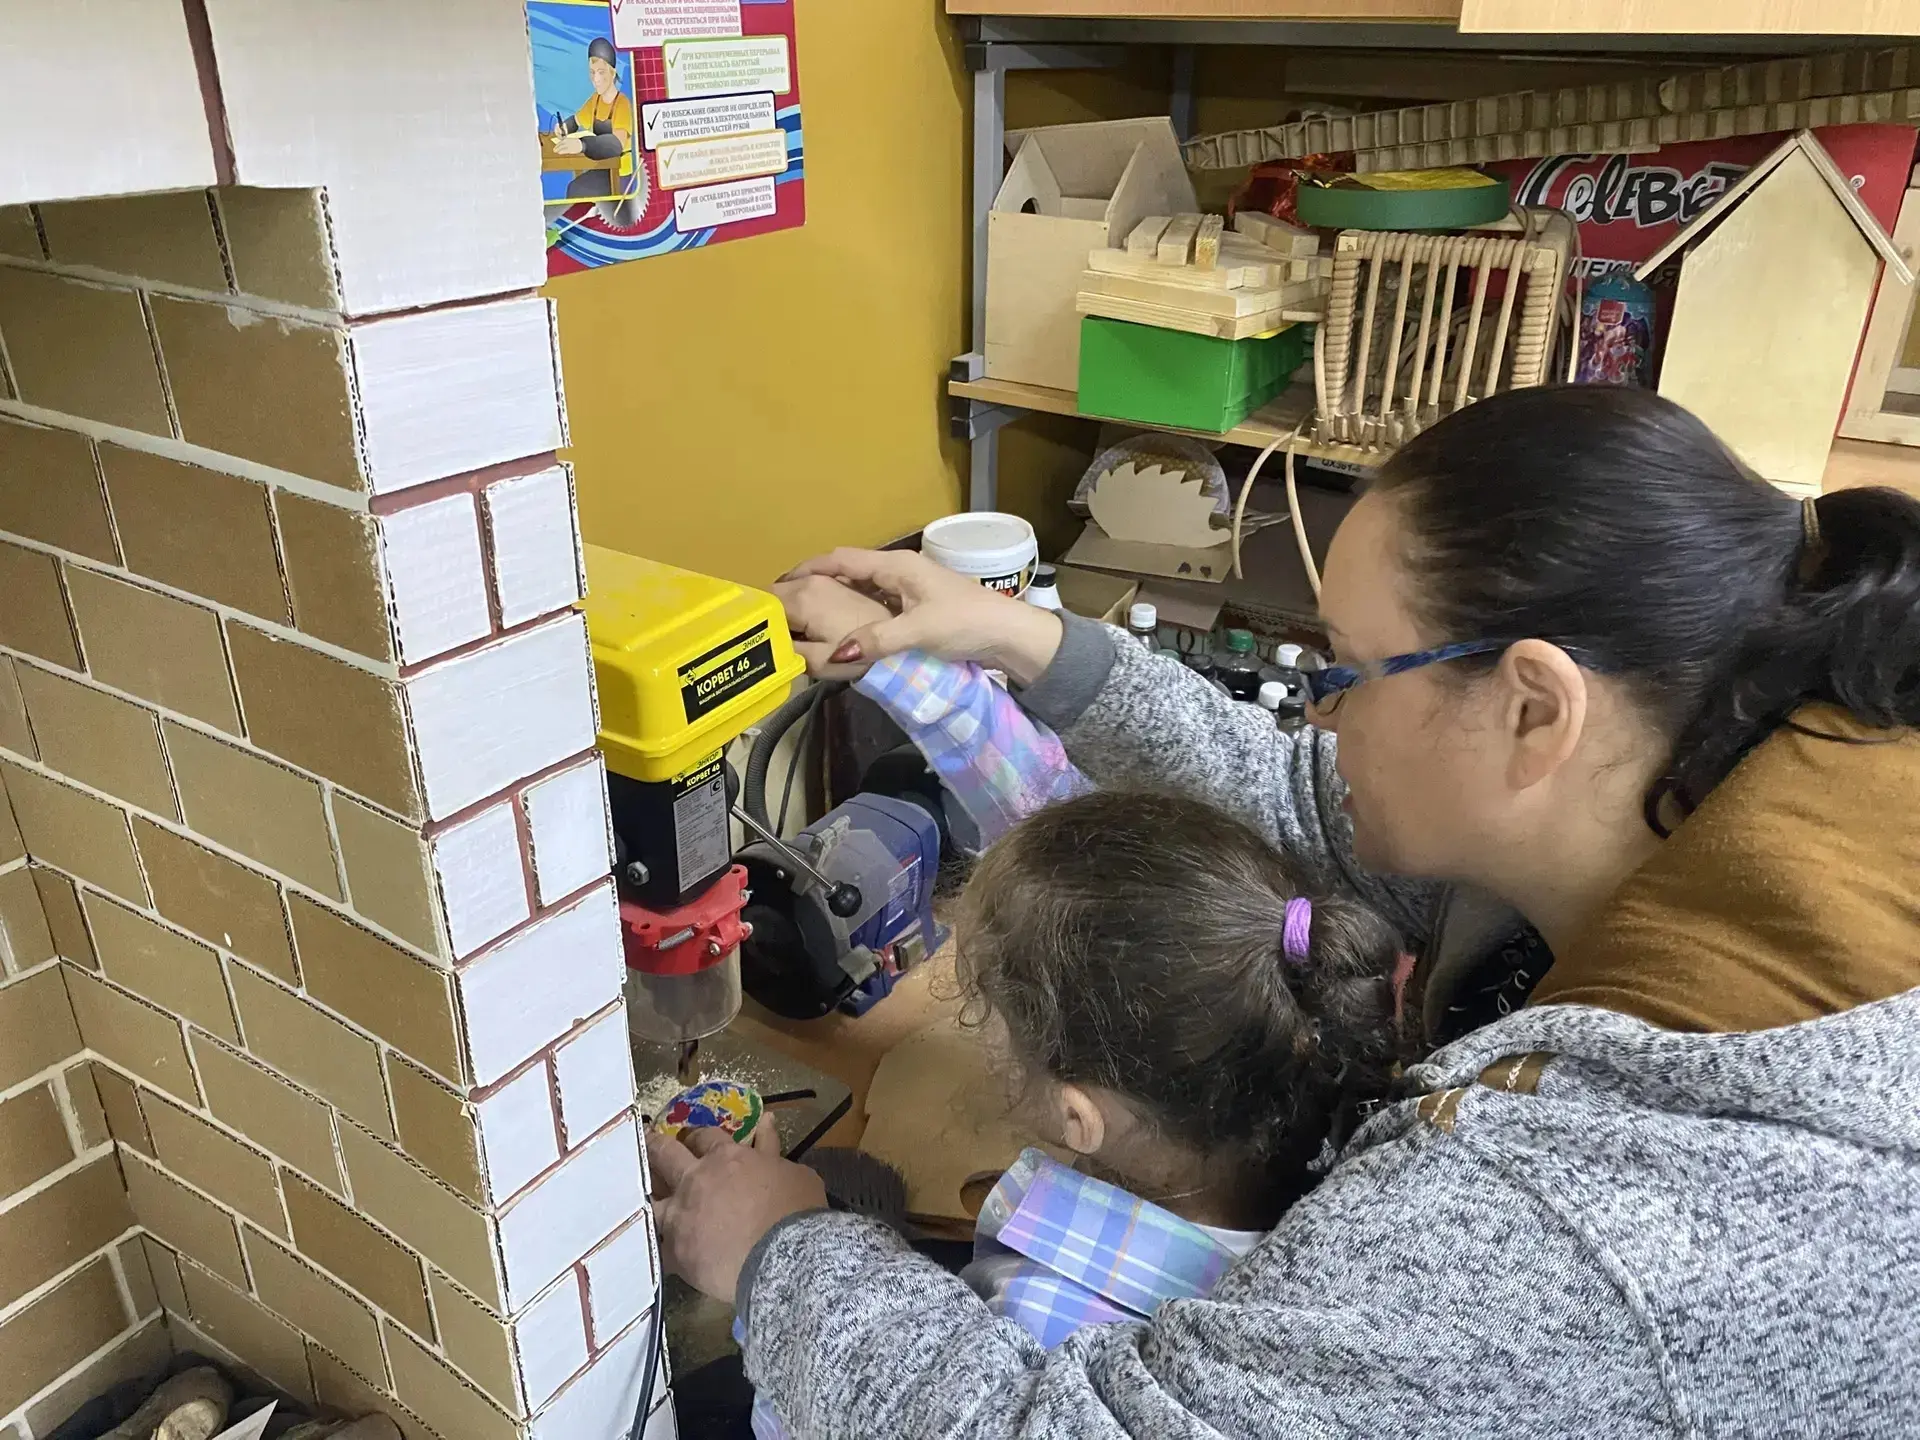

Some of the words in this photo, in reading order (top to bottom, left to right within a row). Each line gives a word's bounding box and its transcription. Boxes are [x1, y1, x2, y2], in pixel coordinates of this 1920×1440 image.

[662, 111, 670, 119] ВО
[671, 108, 706, 118] ИЗБЕЖАНИЕ
[706, 105, 729, 115] ОЖОГОВ
[730, 104, 737, 112] НЕ
[662, 120, 689, 129] СТЕПЕНЬ
[689, 117, 714, 126] НАГРЕВА
[669, 128, 700, 138] НАГРЕТЫХ
[700, 126, 711, 134] ЕГО
[711, 123, 732, 133] ЧАСТЕЙ
[984, 573, 1019, 592] КЛЕЙ
[742, 632, 765, 651] ЭНКОР
[696, 664, 734, 697] КОРВЕТ
[736, 656, 750, 672] 46
[686, 767, 711, 788] КОРВЕТ
[711, 763, 720, 772] 46
